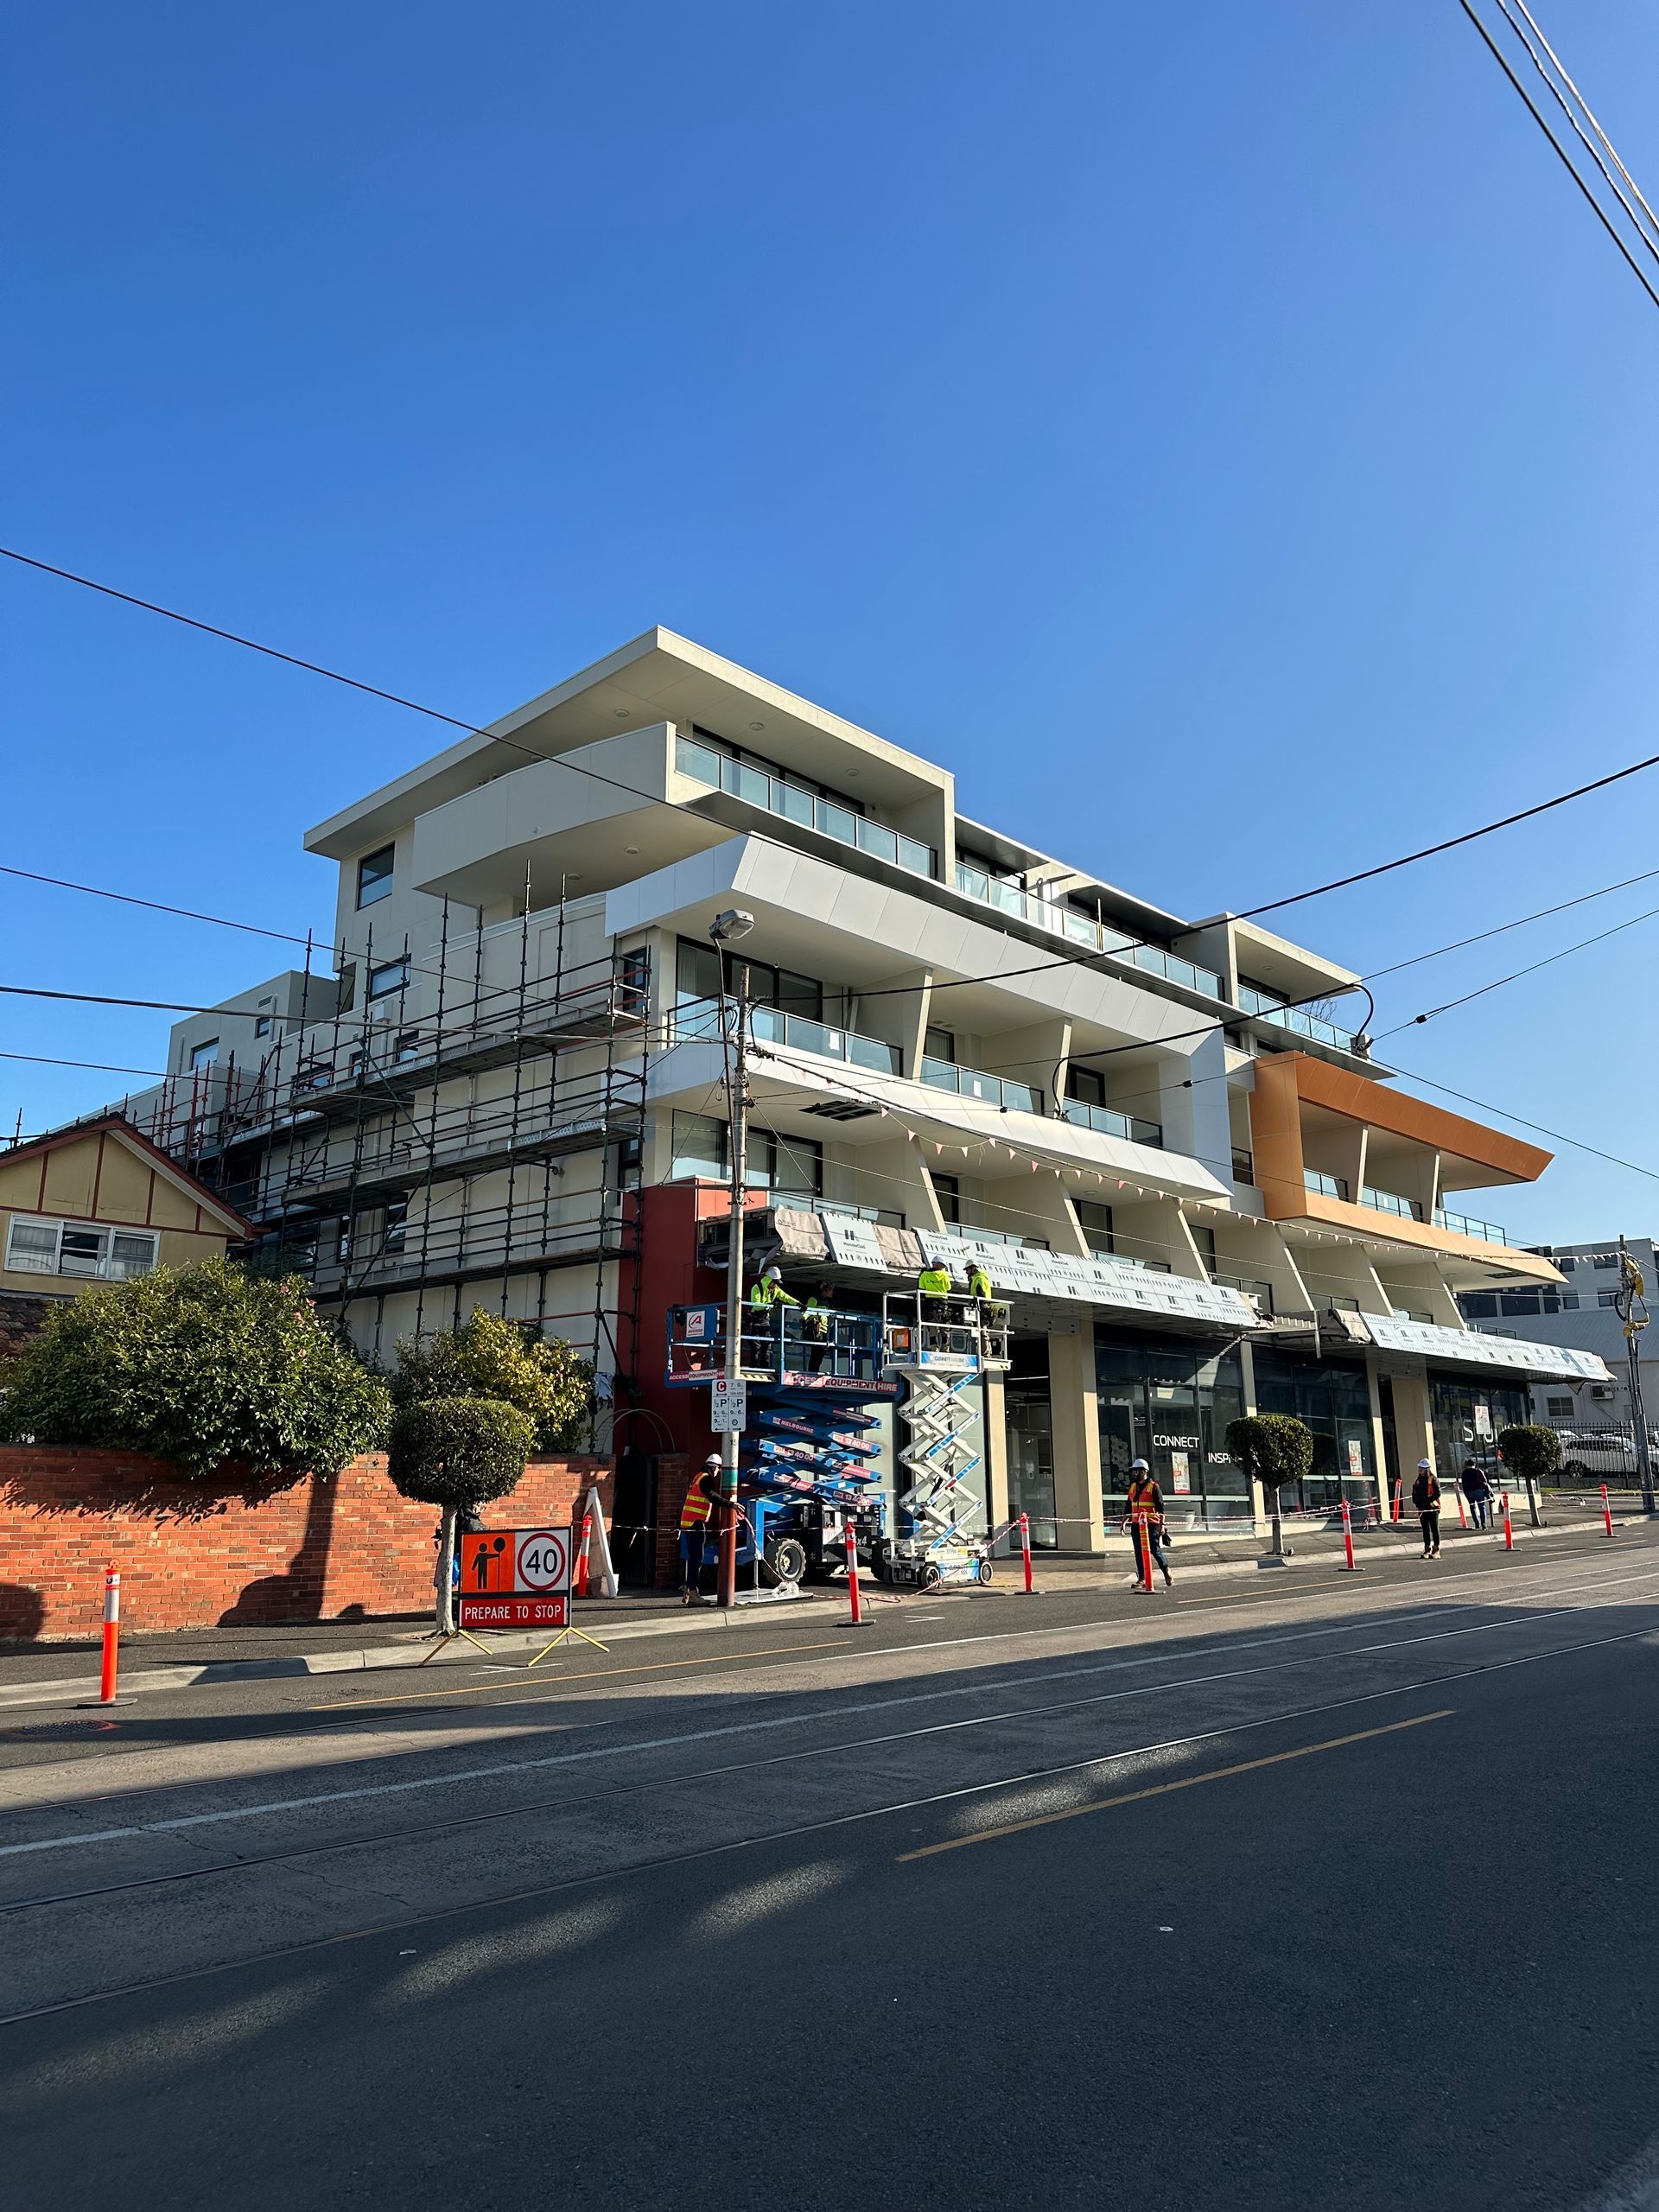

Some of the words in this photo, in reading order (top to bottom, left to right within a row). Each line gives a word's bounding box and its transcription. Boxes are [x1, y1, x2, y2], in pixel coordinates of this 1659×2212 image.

[689, 1371, 716, 1380] EQUIPMENT
[784, 1374, 823, 1386] ACCESS
[825, 1376, 874, 1390] EQUIPMENT
[877, 1382, 898, 1392] HIRE
[780, 1420, 815, 1433] MELBOURNE
[1153, 1434, 1200, 1448] CONNECT
[525, 1548, 558, 1574] 40
[465, 1605, 511, 1620] PREPARE
[516, 1605, 529, 1618] TO
[535, 1605, 562, 1618] STOP
